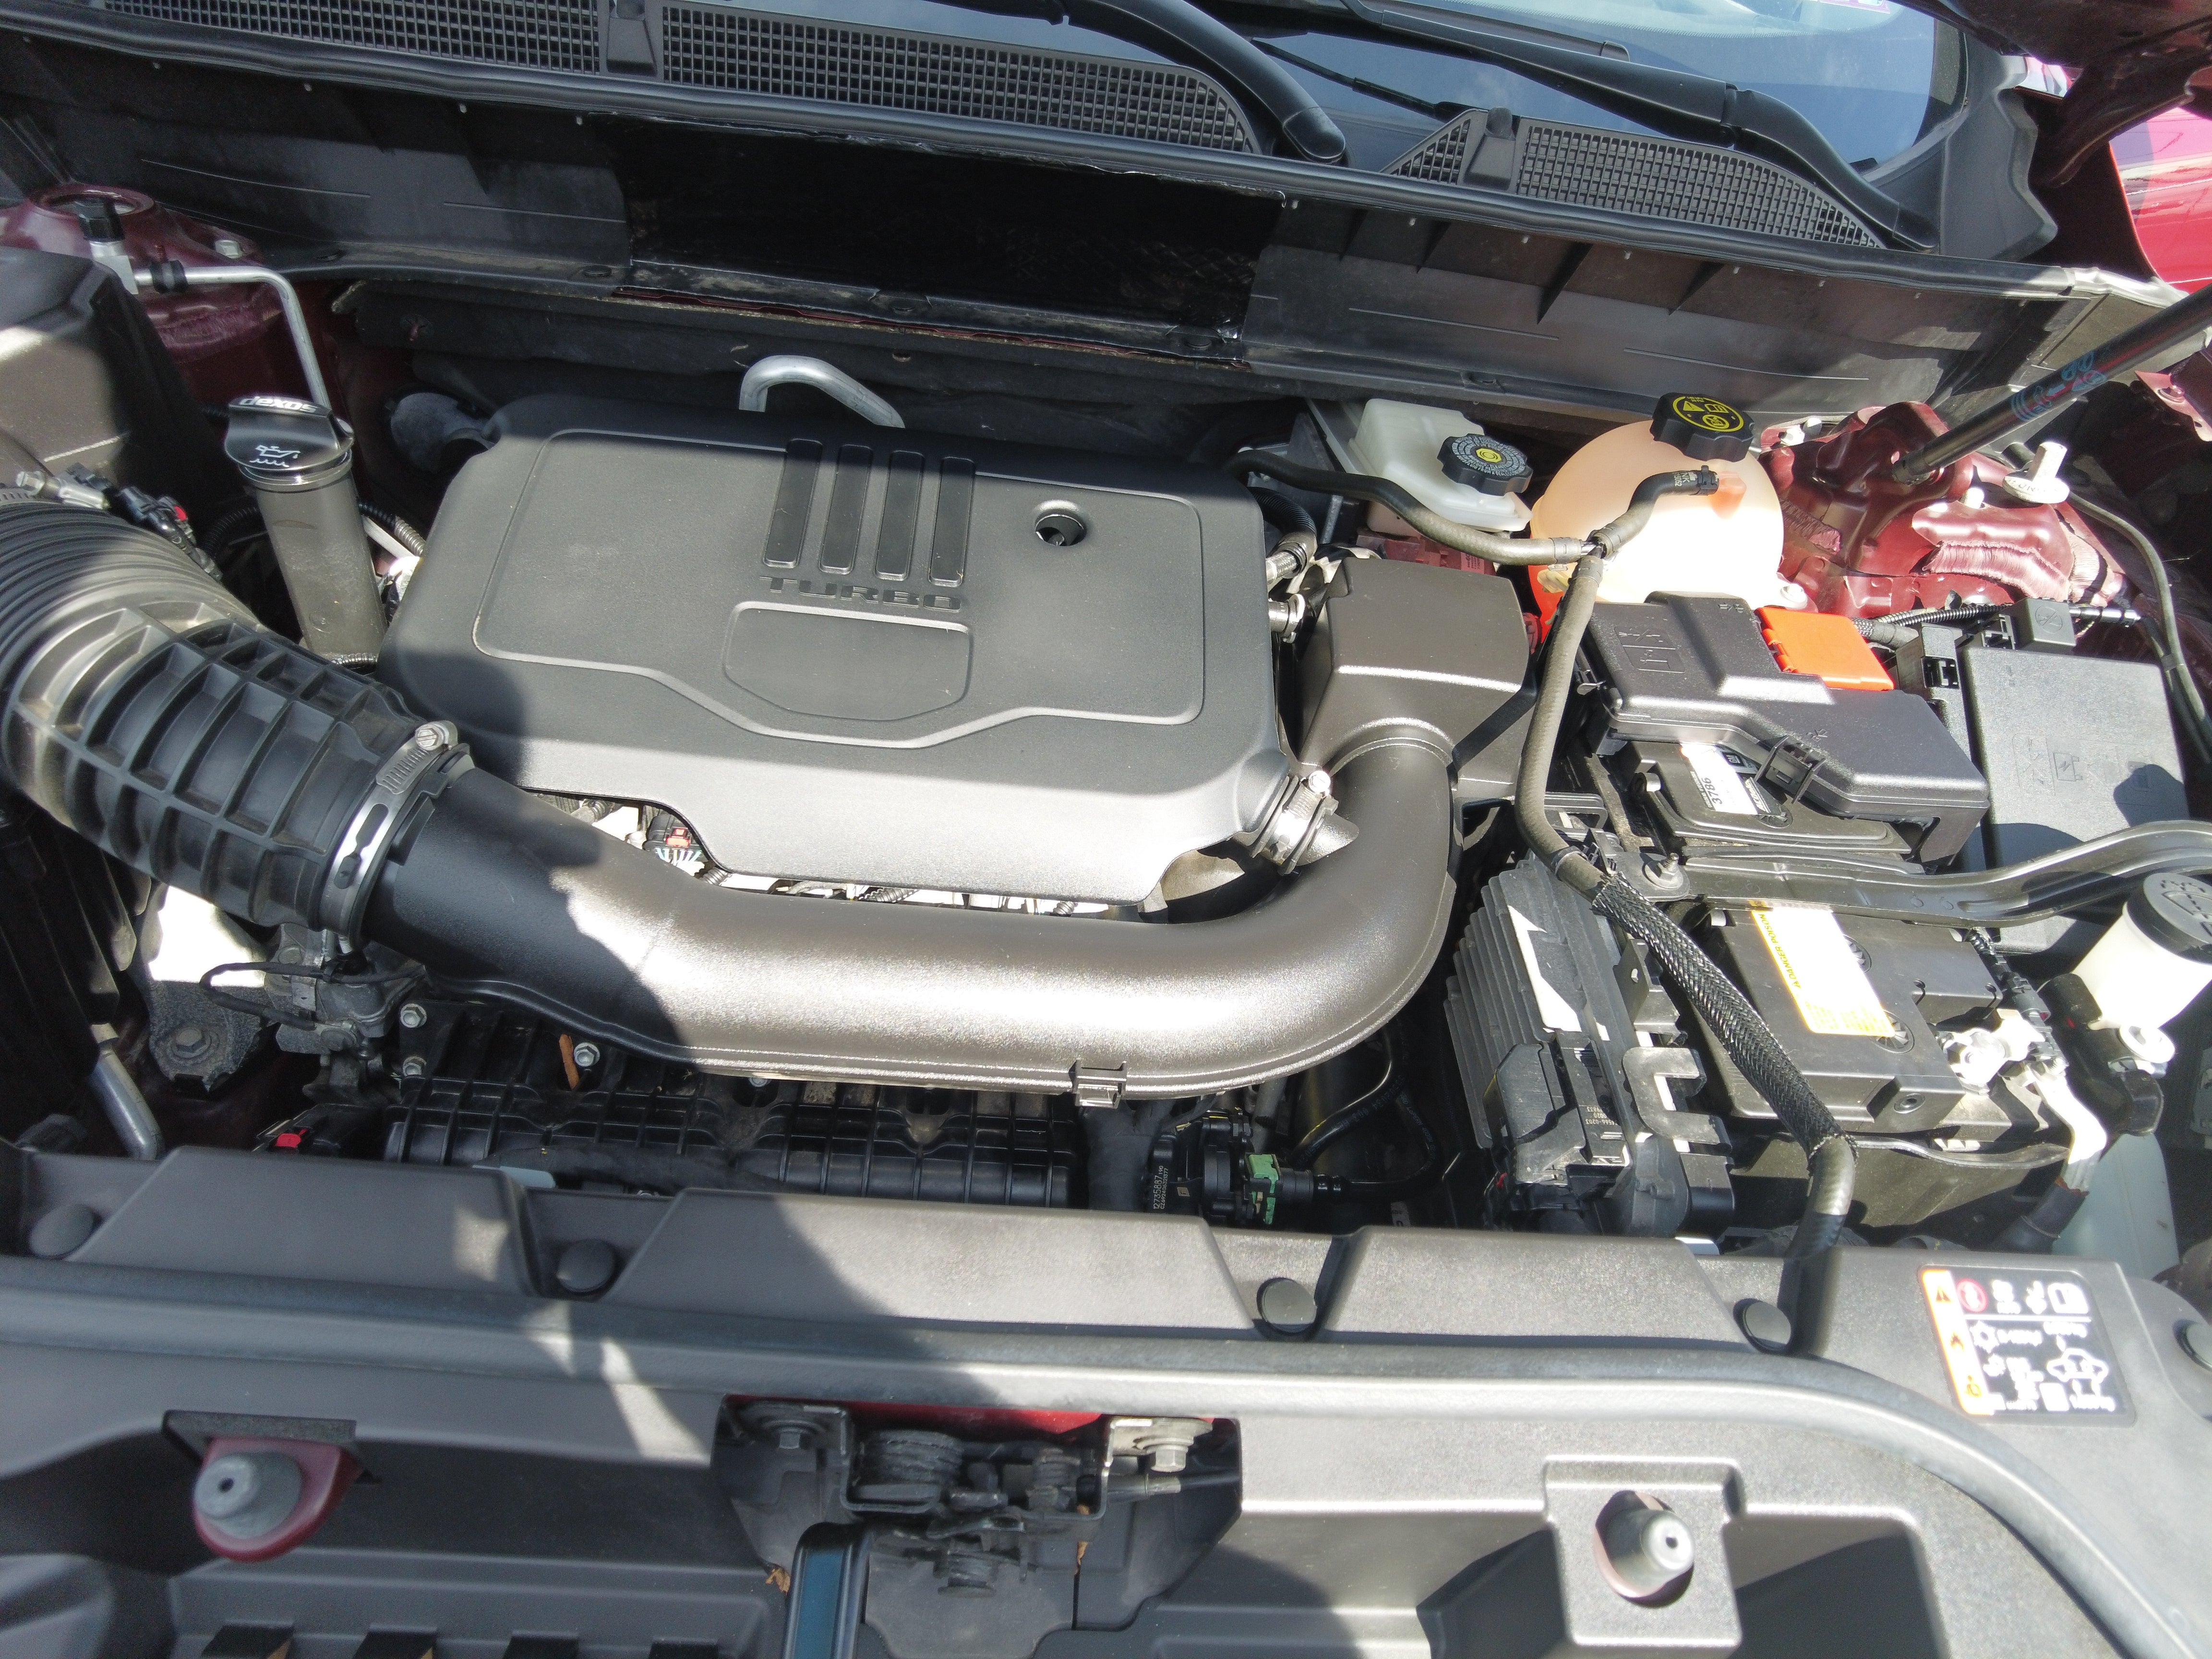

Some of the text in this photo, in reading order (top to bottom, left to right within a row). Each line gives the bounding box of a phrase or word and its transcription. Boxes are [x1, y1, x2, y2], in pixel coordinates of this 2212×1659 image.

[240, 395, 318, 413] dexos
[759, 575, 962, 612] TURBO
[1726, 754, 1741, 764] GM
[1701, 777, 1722, 805] 3786
[1758, 913, 1797, 980] DANGER POISON
